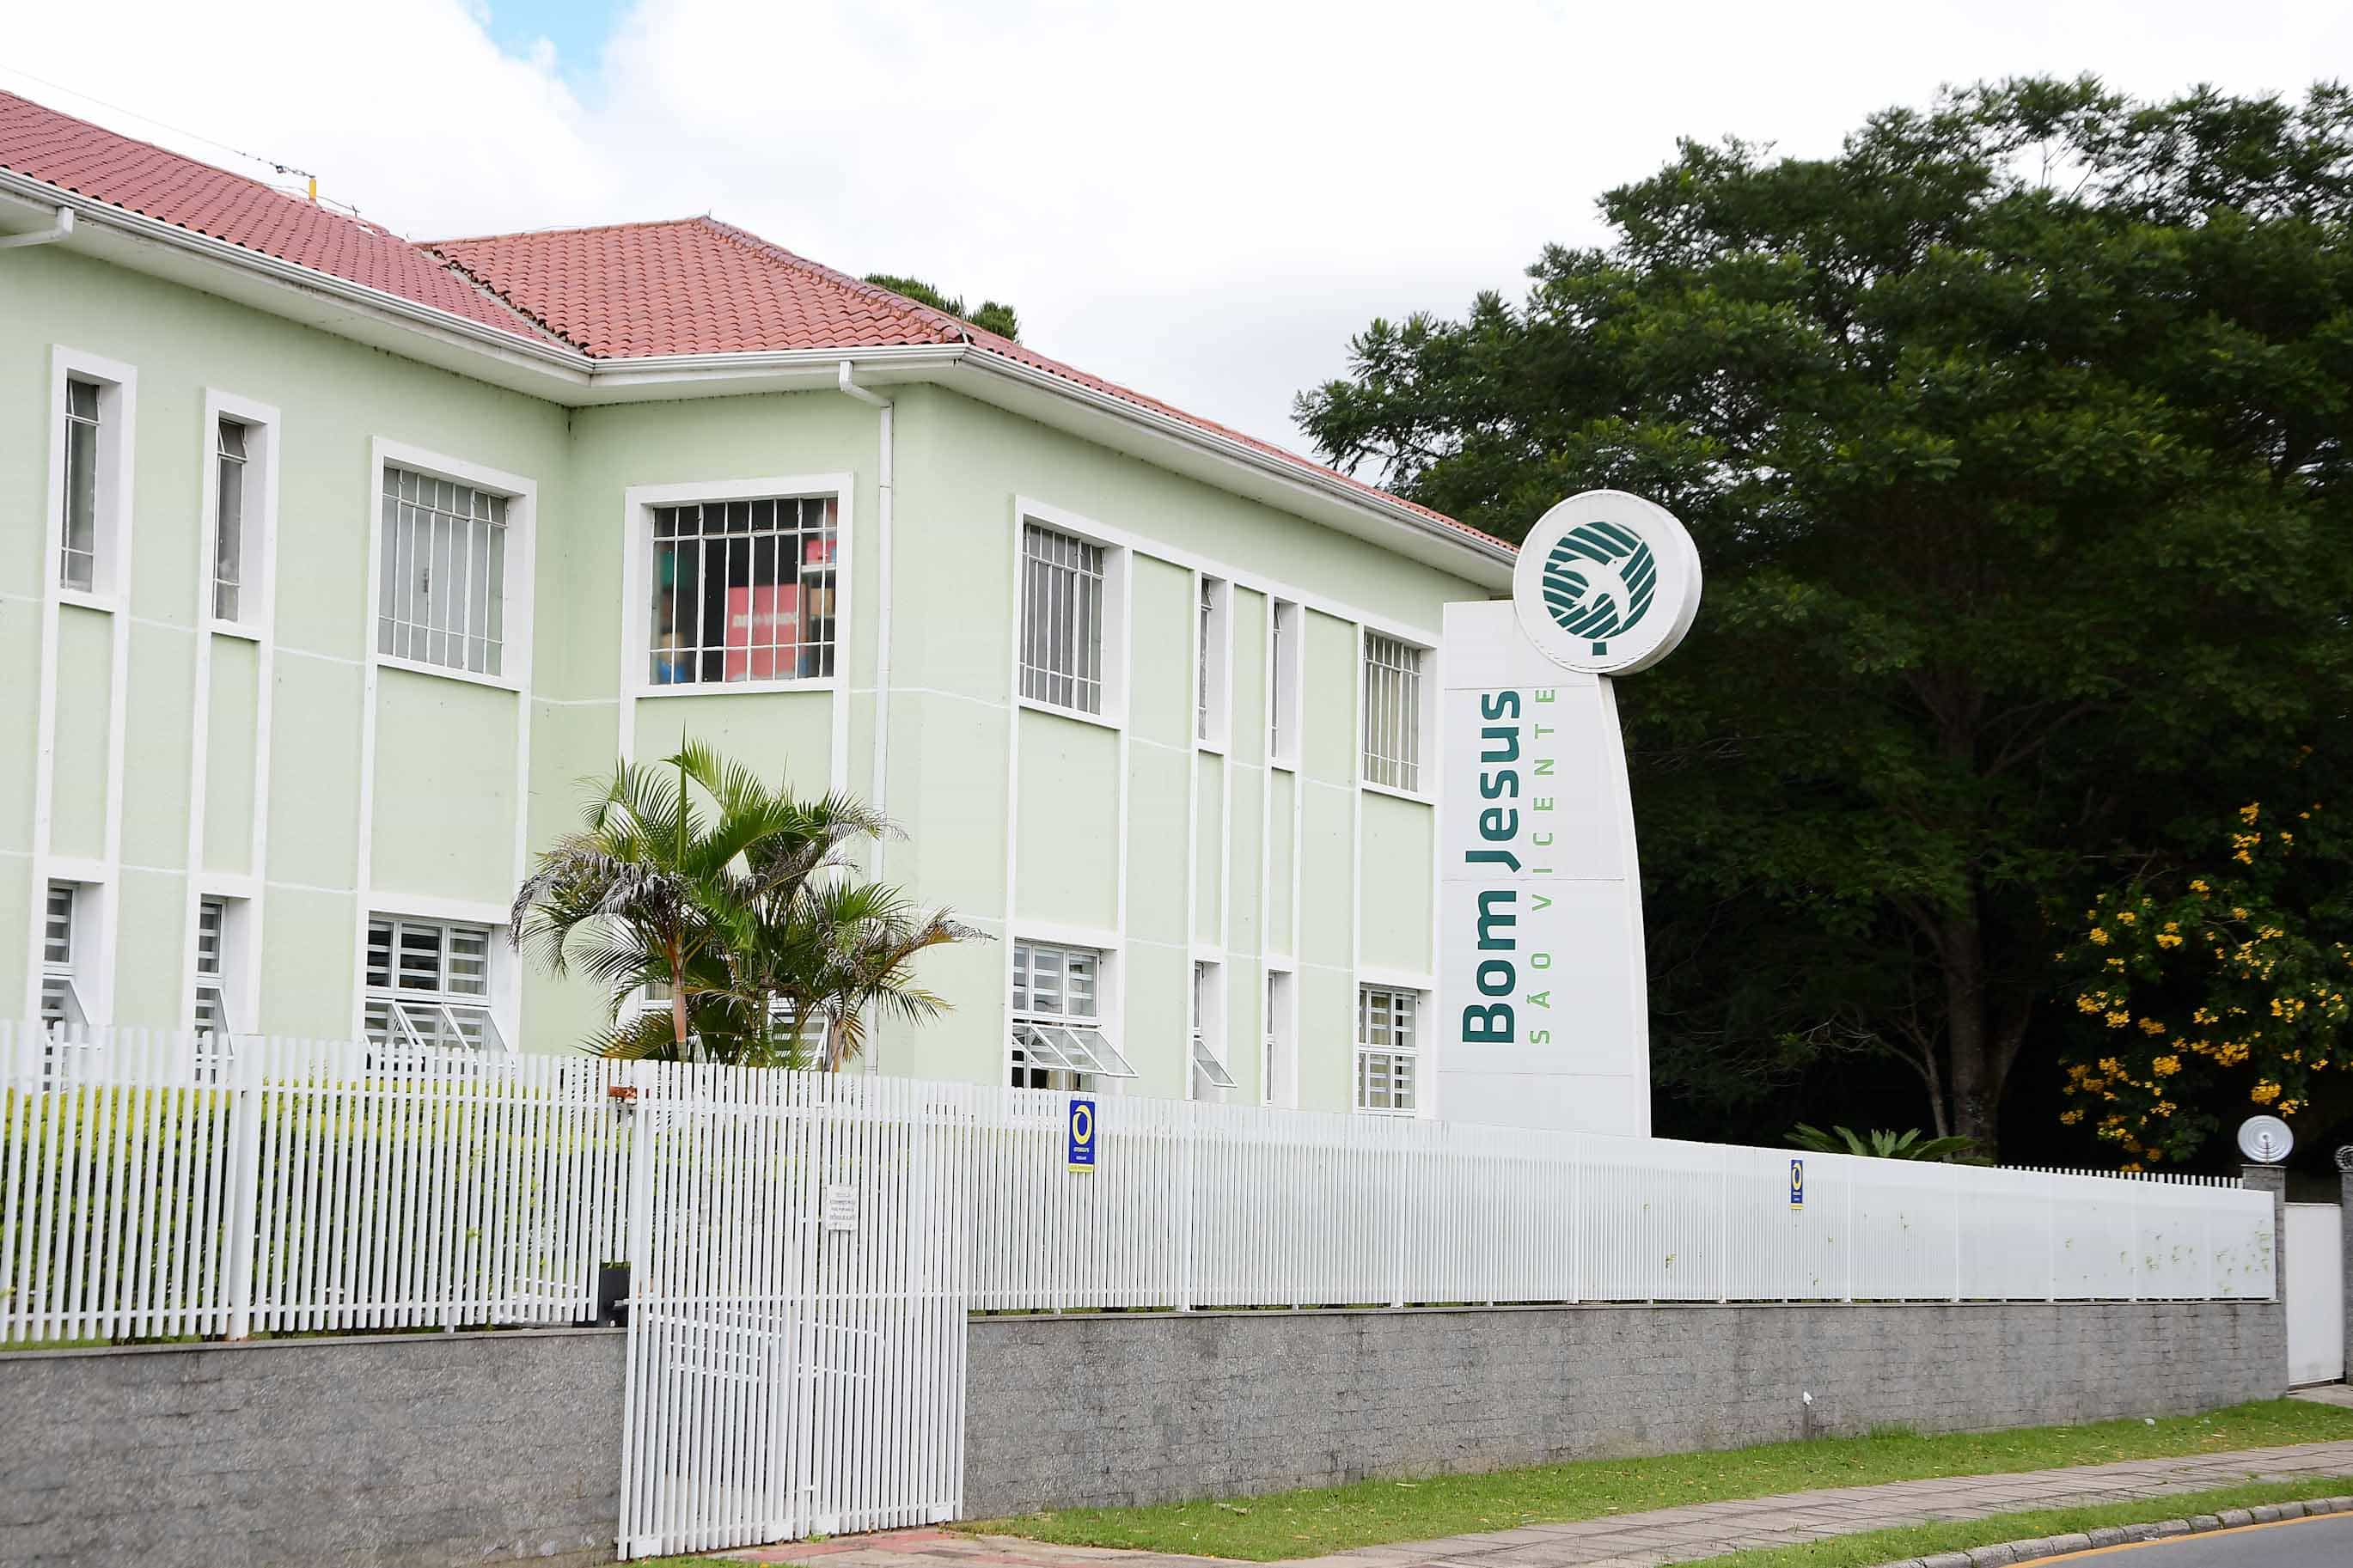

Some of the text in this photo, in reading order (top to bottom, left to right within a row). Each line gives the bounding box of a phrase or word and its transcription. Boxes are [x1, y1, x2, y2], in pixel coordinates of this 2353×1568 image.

[1462, 690, 1521, 1043] Bom Jesus
[1526, 688, 1555, 1045] SÃO VICENTE
